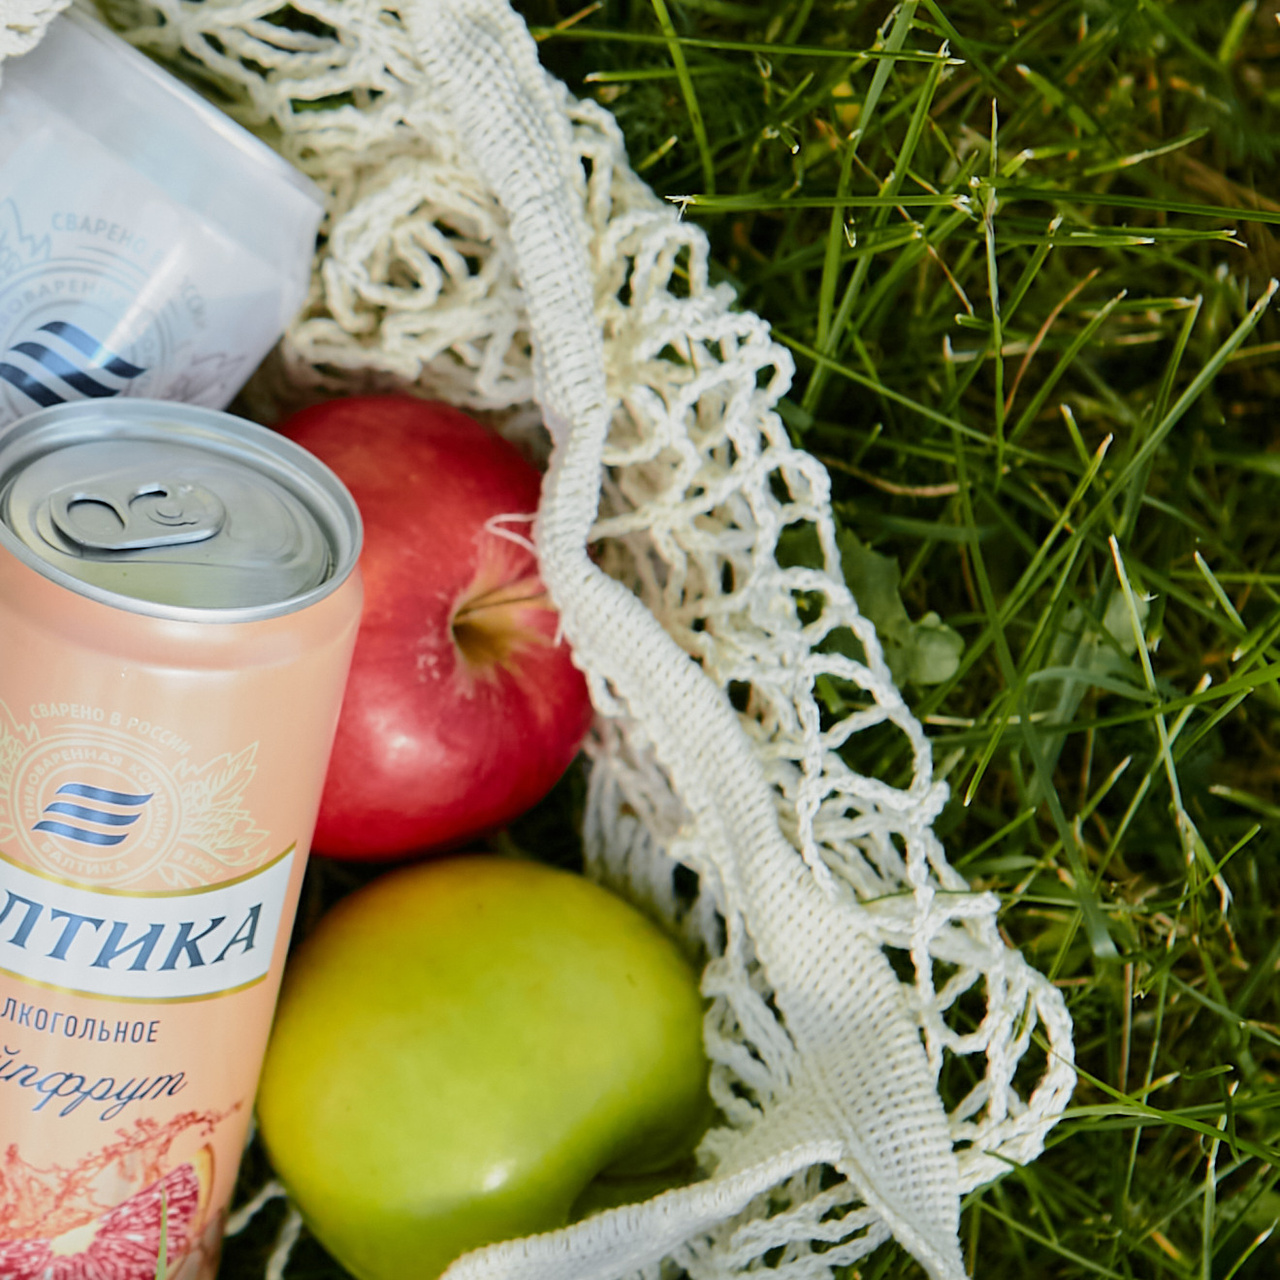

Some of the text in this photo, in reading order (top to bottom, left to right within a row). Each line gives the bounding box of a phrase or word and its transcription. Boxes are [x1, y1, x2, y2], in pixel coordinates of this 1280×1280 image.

[51, 211, 148, 254] СВАРЕНО
[30, 703, 193, 756] СВАРЕНО В РОССИИ
[24, 748, 169, 850] ПИВОВАРЕННАЯ КОМПАНИЯ
[40, 841, 129, 876] БАЛТИКА
